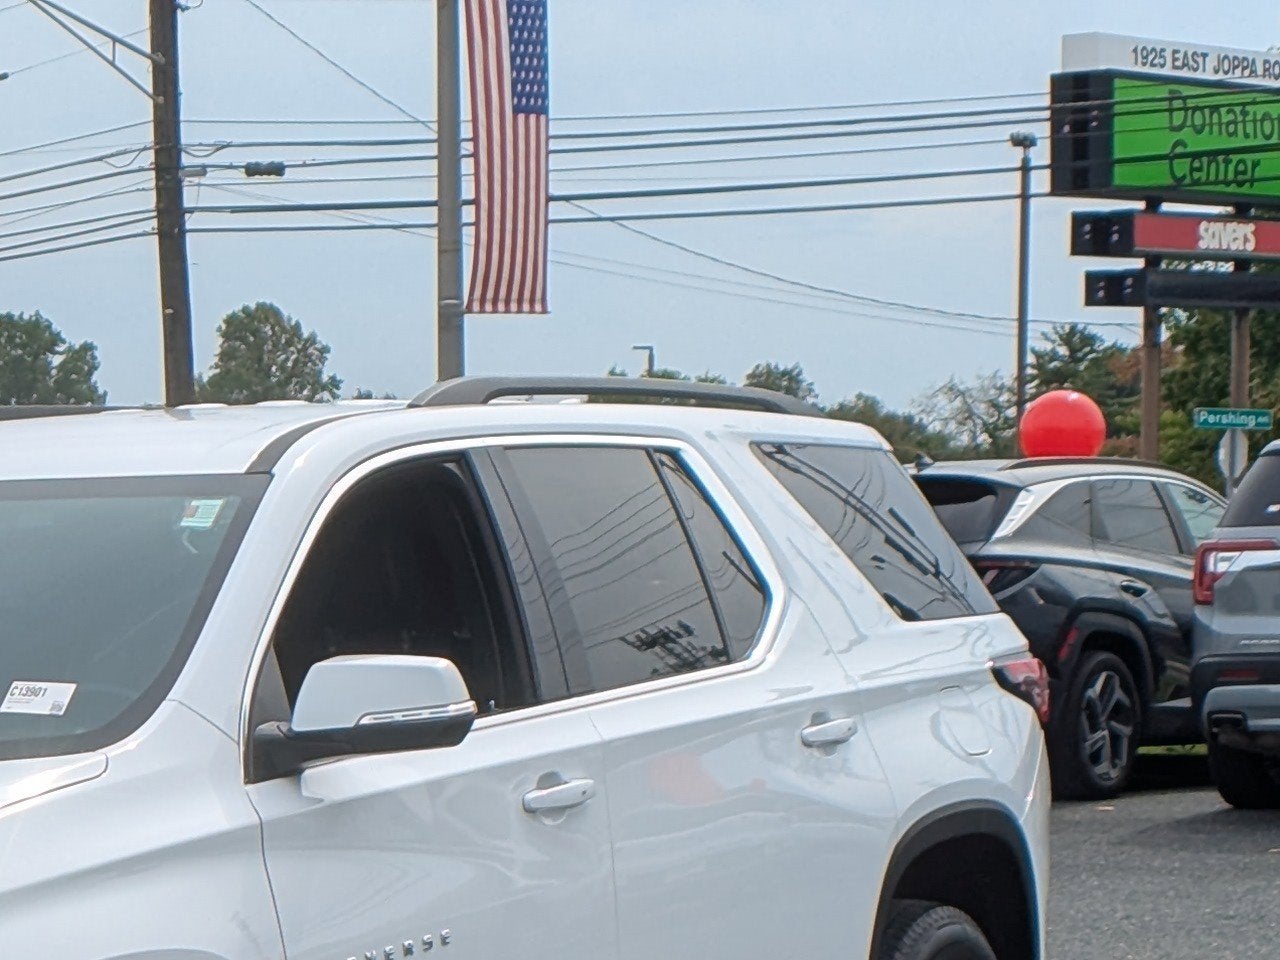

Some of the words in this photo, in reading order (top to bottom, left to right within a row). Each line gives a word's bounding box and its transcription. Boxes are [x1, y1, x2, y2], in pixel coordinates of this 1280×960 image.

[1132, 45, 1167, 69] 1925
[1171, 49, 1209, 73] EAST
[1213, 54, 1258, 78] JOPPA
[1168, 88, 1280, 143] Donatio
[1168, 138, 1262, 189] Center
[1199, 410, 1256, 427] Pershing
